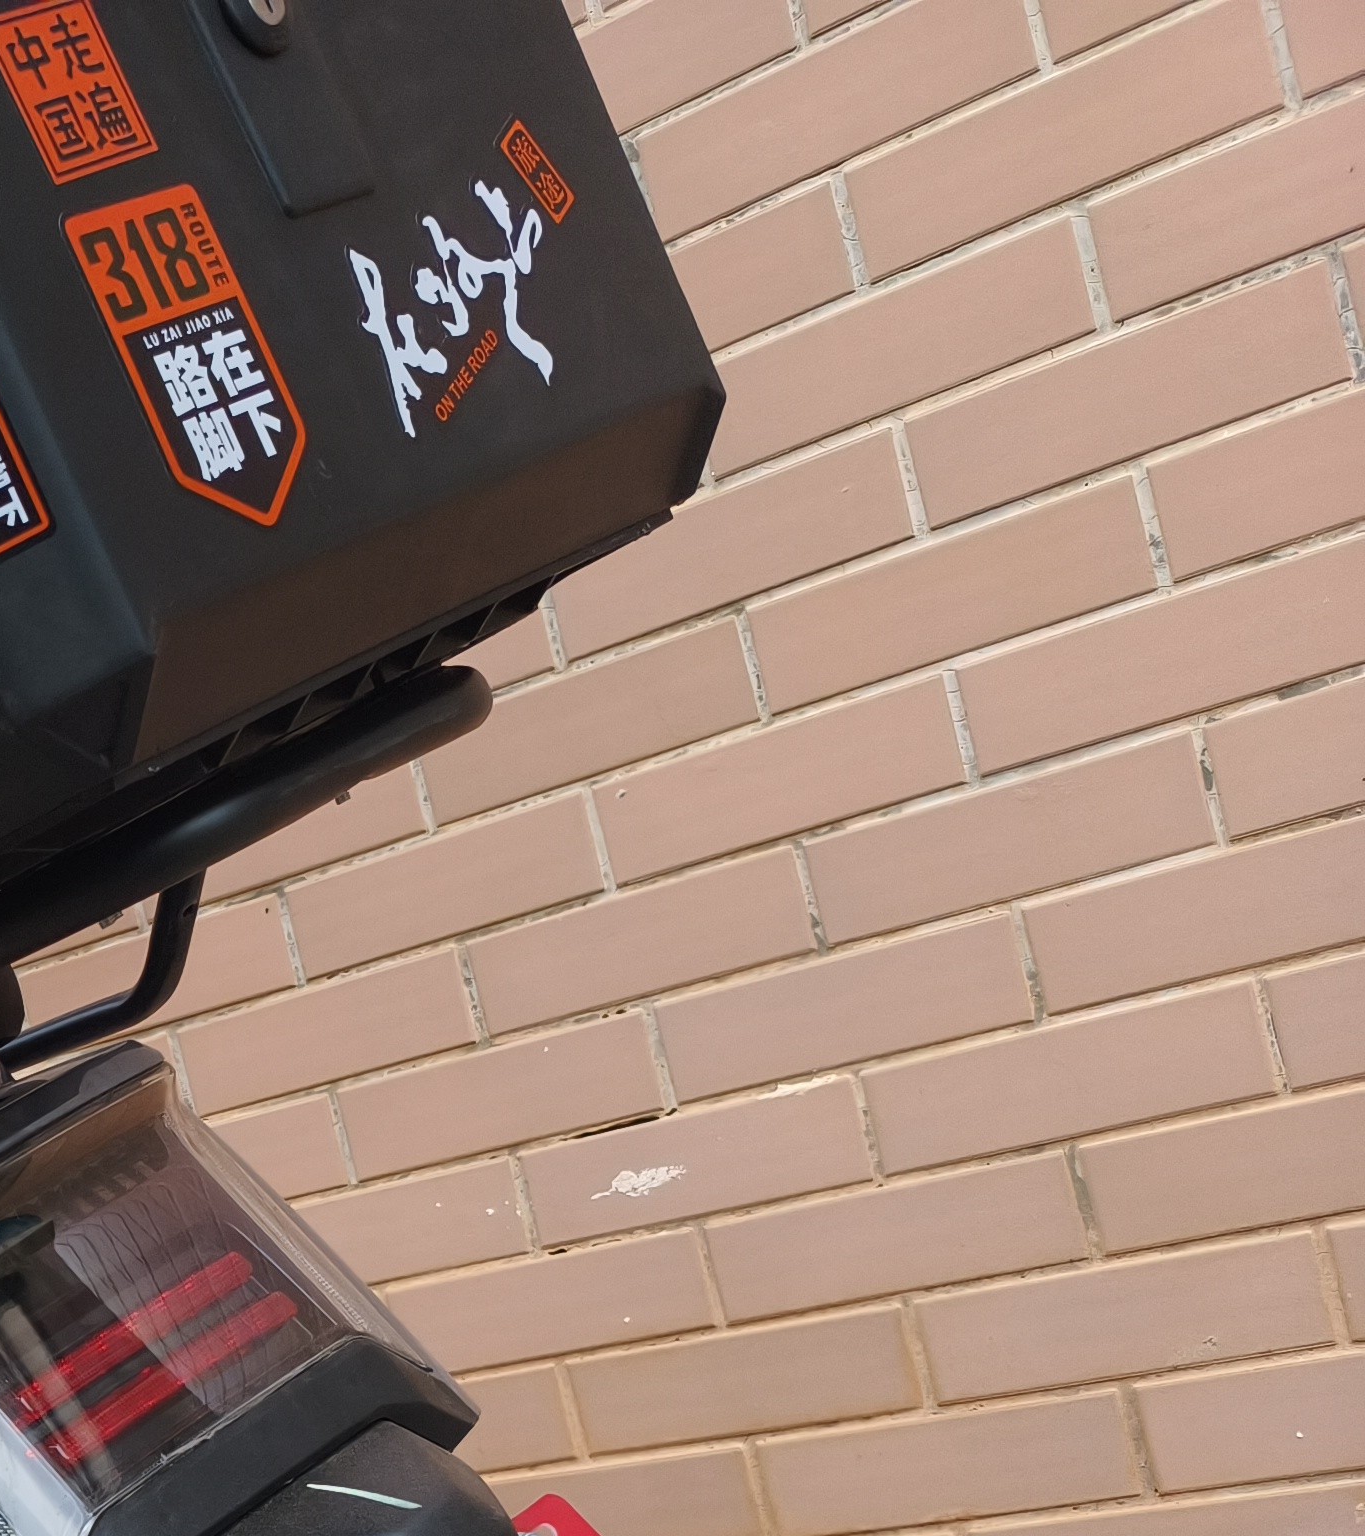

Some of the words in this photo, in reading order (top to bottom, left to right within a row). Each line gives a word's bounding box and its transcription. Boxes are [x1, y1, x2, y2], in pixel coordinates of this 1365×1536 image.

[6, 26, 94, 163] 中国
[50, 14, 137, 150] 走遍
[80, 208, 210, 323] 318
[180, 203, 230, 287] ROUTE
[153, 329, 265, 417] 路在
[434, 397, 455, 423] ON
[449, 366, 474, 401] THE
[468, 329, 499, 371] ROAD
[182, 390, 281, 482] 脚下
